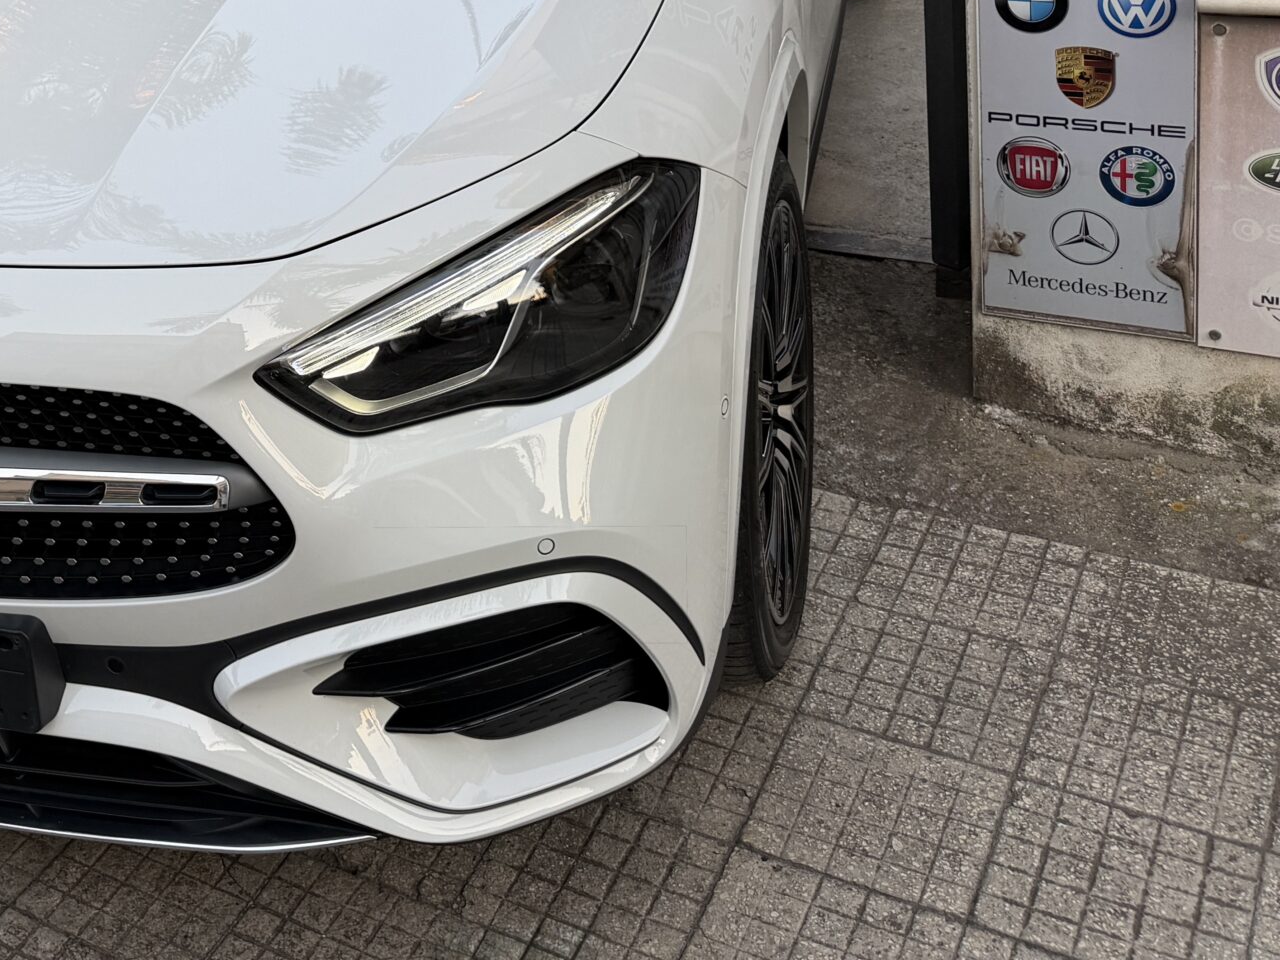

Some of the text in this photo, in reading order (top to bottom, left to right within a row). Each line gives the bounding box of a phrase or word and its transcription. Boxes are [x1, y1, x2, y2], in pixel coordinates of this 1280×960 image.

[987, 111, 1187, 138] PORSCHE
[1014, 154, 1055, 181] FIAT
[1101, 146, 1174, 181] ALFA ROMEO
[1007, 268, 1168, 304] Mercedes-Benz
[1261, 295, 1280, 305] NI
